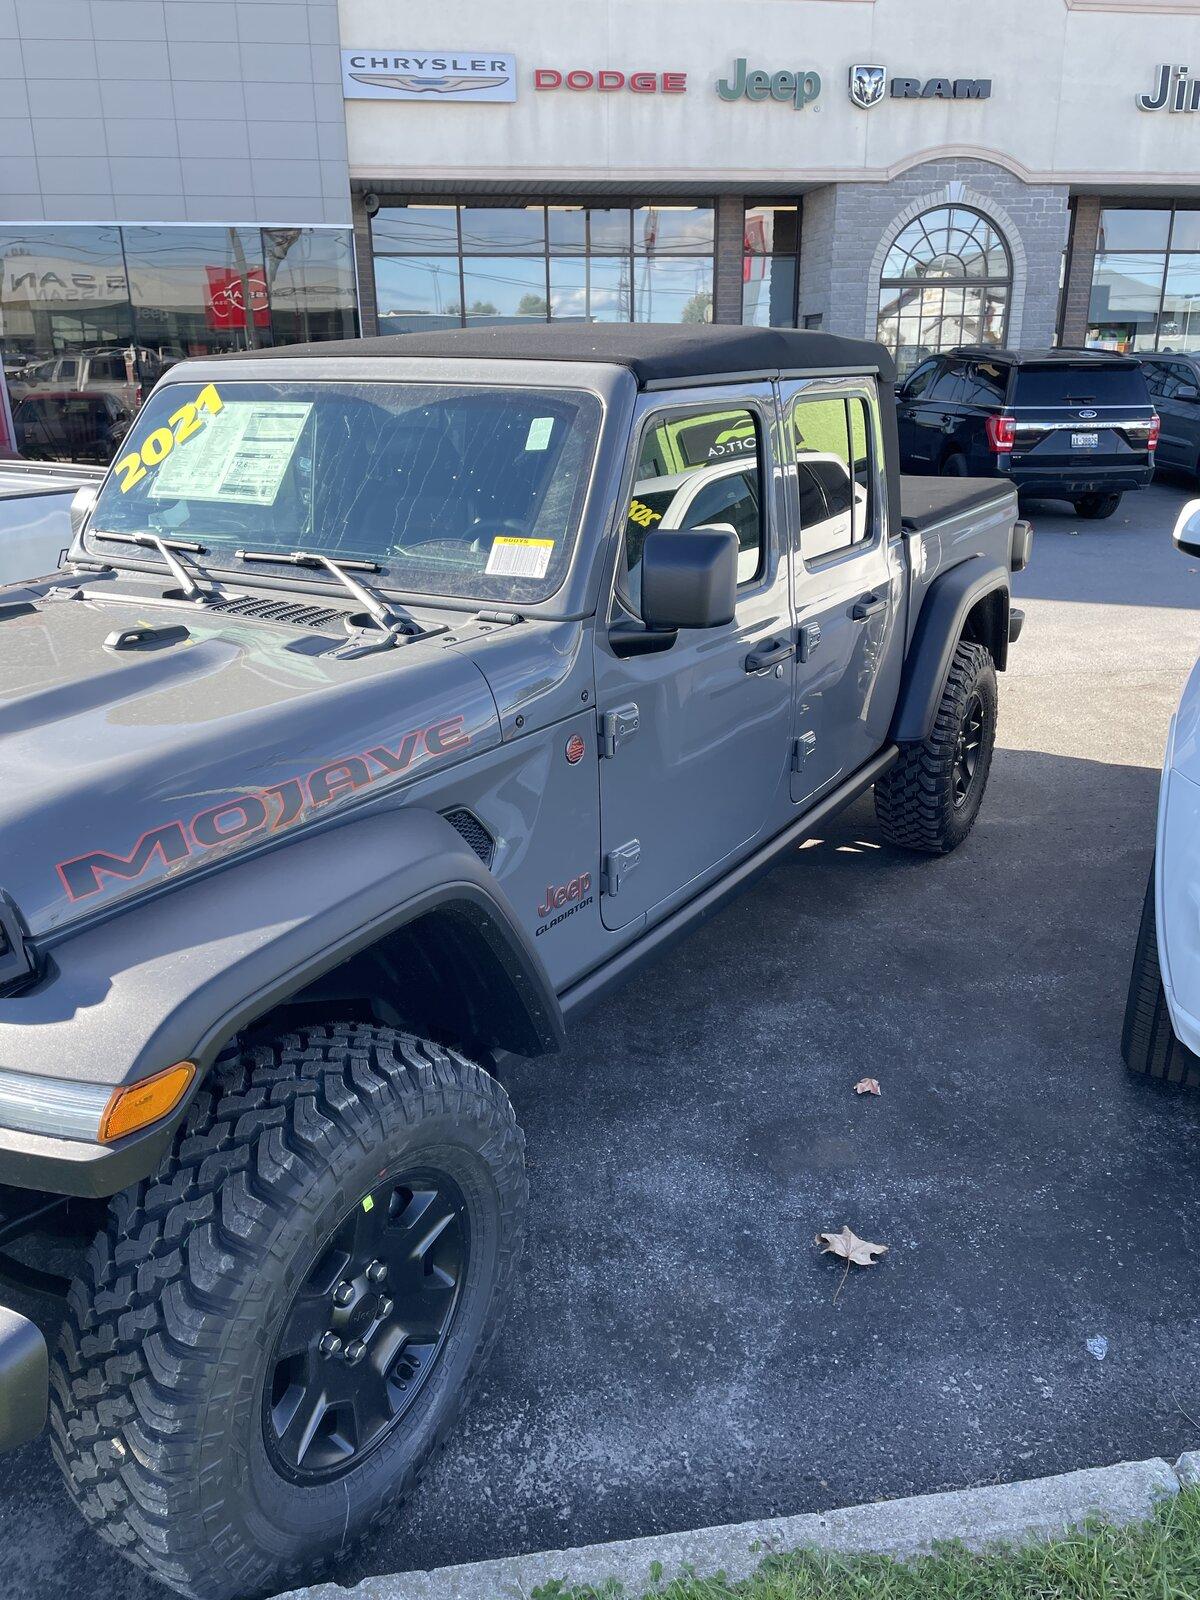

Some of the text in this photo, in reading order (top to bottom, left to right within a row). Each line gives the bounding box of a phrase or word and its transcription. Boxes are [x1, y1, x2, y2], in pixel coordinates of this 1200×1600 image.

[350, 56, 507, 72] CHRYSLER
[535, 69, 687, 93] DODGE
[716, 58, 821, 111] Jeep
[890, 77, 992, 99] RAM
[114, 383, 224, 494] 2021
[56, 715, 470, 902] MOJAVE
[536, 896, 593, 937] GLADIATOR
[538, 872, 591, 918] Jeep
